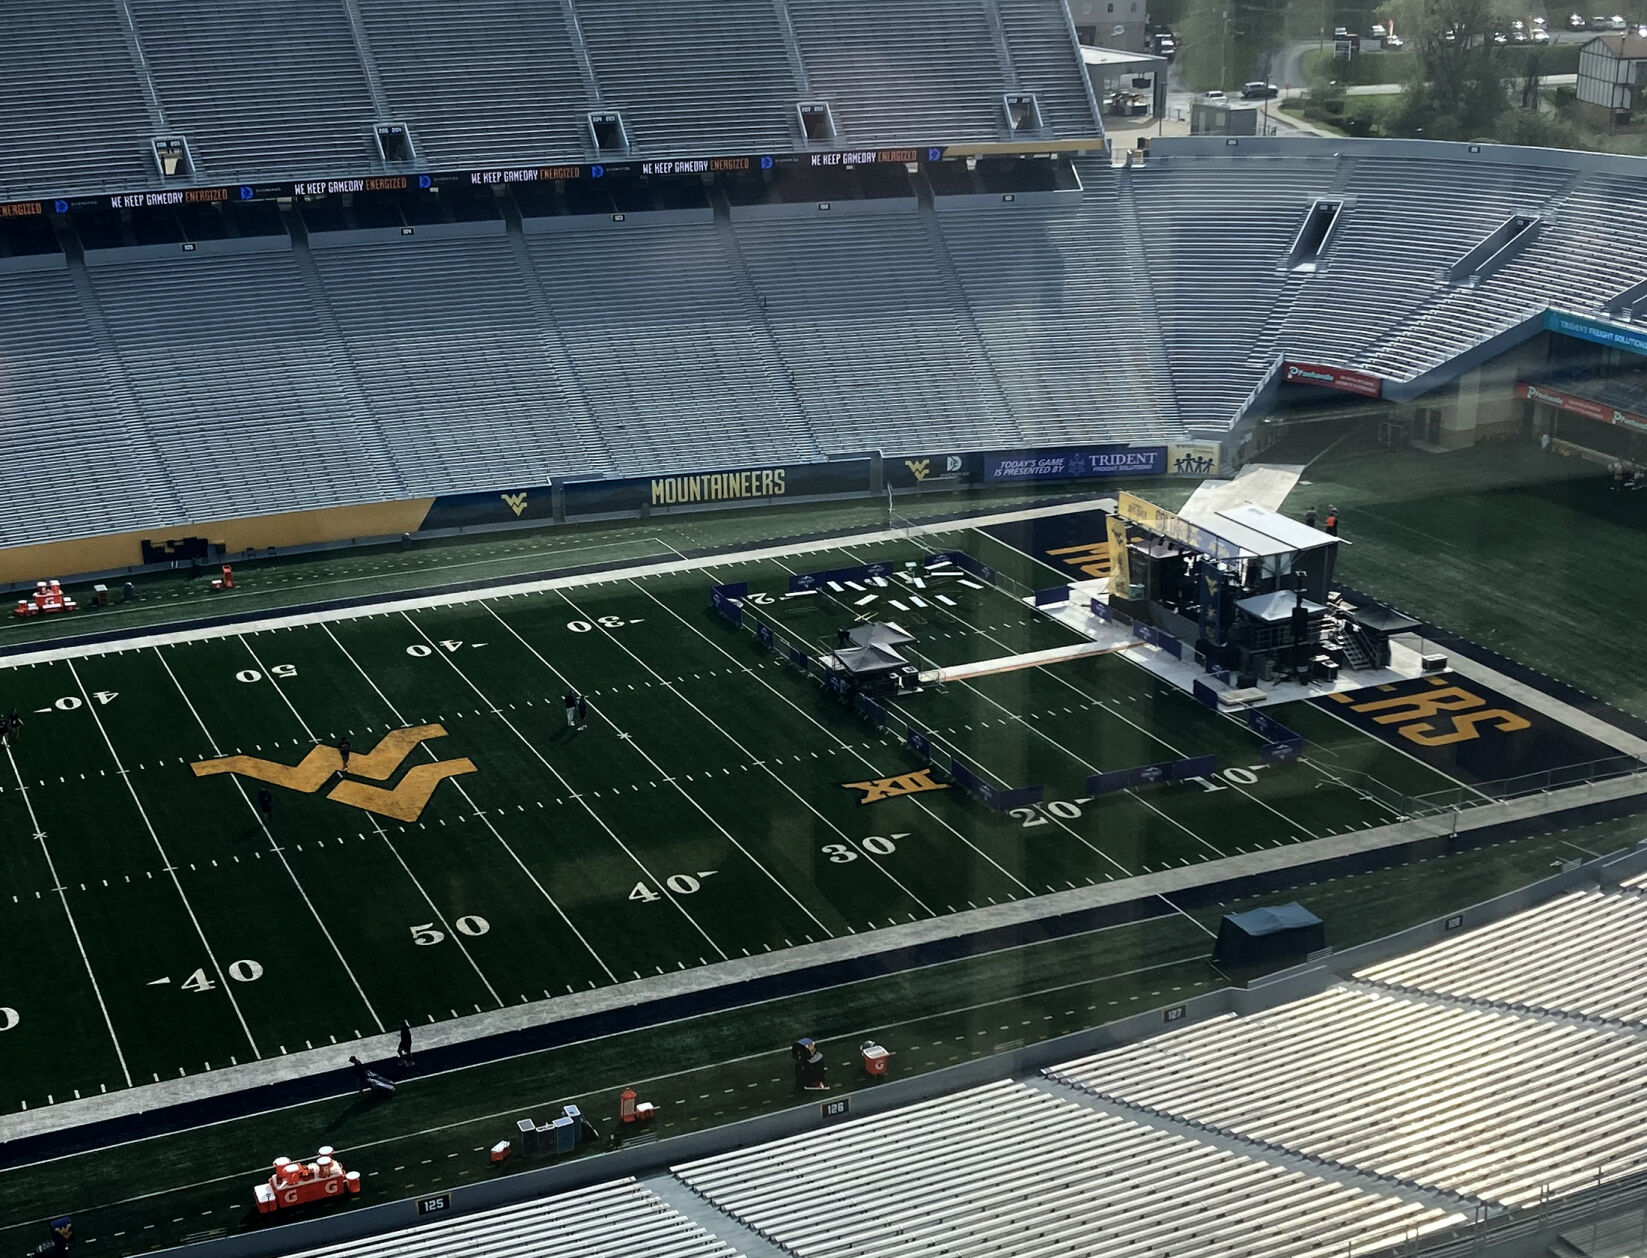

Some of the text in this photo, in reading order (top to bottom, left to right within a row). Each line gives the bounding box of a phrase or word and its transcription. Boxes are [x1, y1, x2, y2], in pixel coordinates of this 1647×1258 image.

[642, 158, 750, 175] WE KEEP GAMEDAY ENERGIZED
[811, 150, 917, 167] WE KEEP GAMEDAY ENERGIZED
[471, 173, 482, 185] WE
[483, 171, 502, 184] KEEP
[503, 169, 538, 183] GAMEDAY
[540, 167, 580, 180] ENERGIZED
[294, 184, 306, 196] WE
[307, 182, 327, 194] KEEP
[328, 180, 364, 194] GAMEDAY
[365, 177, 408, 191] ENERGIZED
[111, 196, 122, 209] WE
[124, 194, 144, 208] KEEP
[146, 192, 183, 206] GAMEDAY
[185, 188, 229, 202] ENERGIZED
[1000, 457, 1065, 470] TODAY'S GAME
[1088, 452, 1158, 466] TRIDENT
[994, 465, 1066, 477] IS PRESENTED BY
[1119, 464, 1153, 472] SOLUTIONS
[652, 469, 786, 505] MOUNTAINEERS
[567, 616, 625, 633] 30
[406, 640, 463, 657] 40
[236, 664, 298, 682] 50
[55, 690, 119, 710] 40
[1184, 768, 1258, 793] 10
[1009, 801, 1082, 828] 20
[821, 836, 896, 863] 30
[628, 873, 701, 903] 40
[409, 915, 490, 945] 50
[181, 959, 264, 993] 40
[1167, 1007, 1183, 1020] 127
[827, 1102, 845, 1115] 126
[324, 1180, 338, 1194] G
[284, 1190, 298, 1203] G
[424, 1198, 444, 1212] 125
